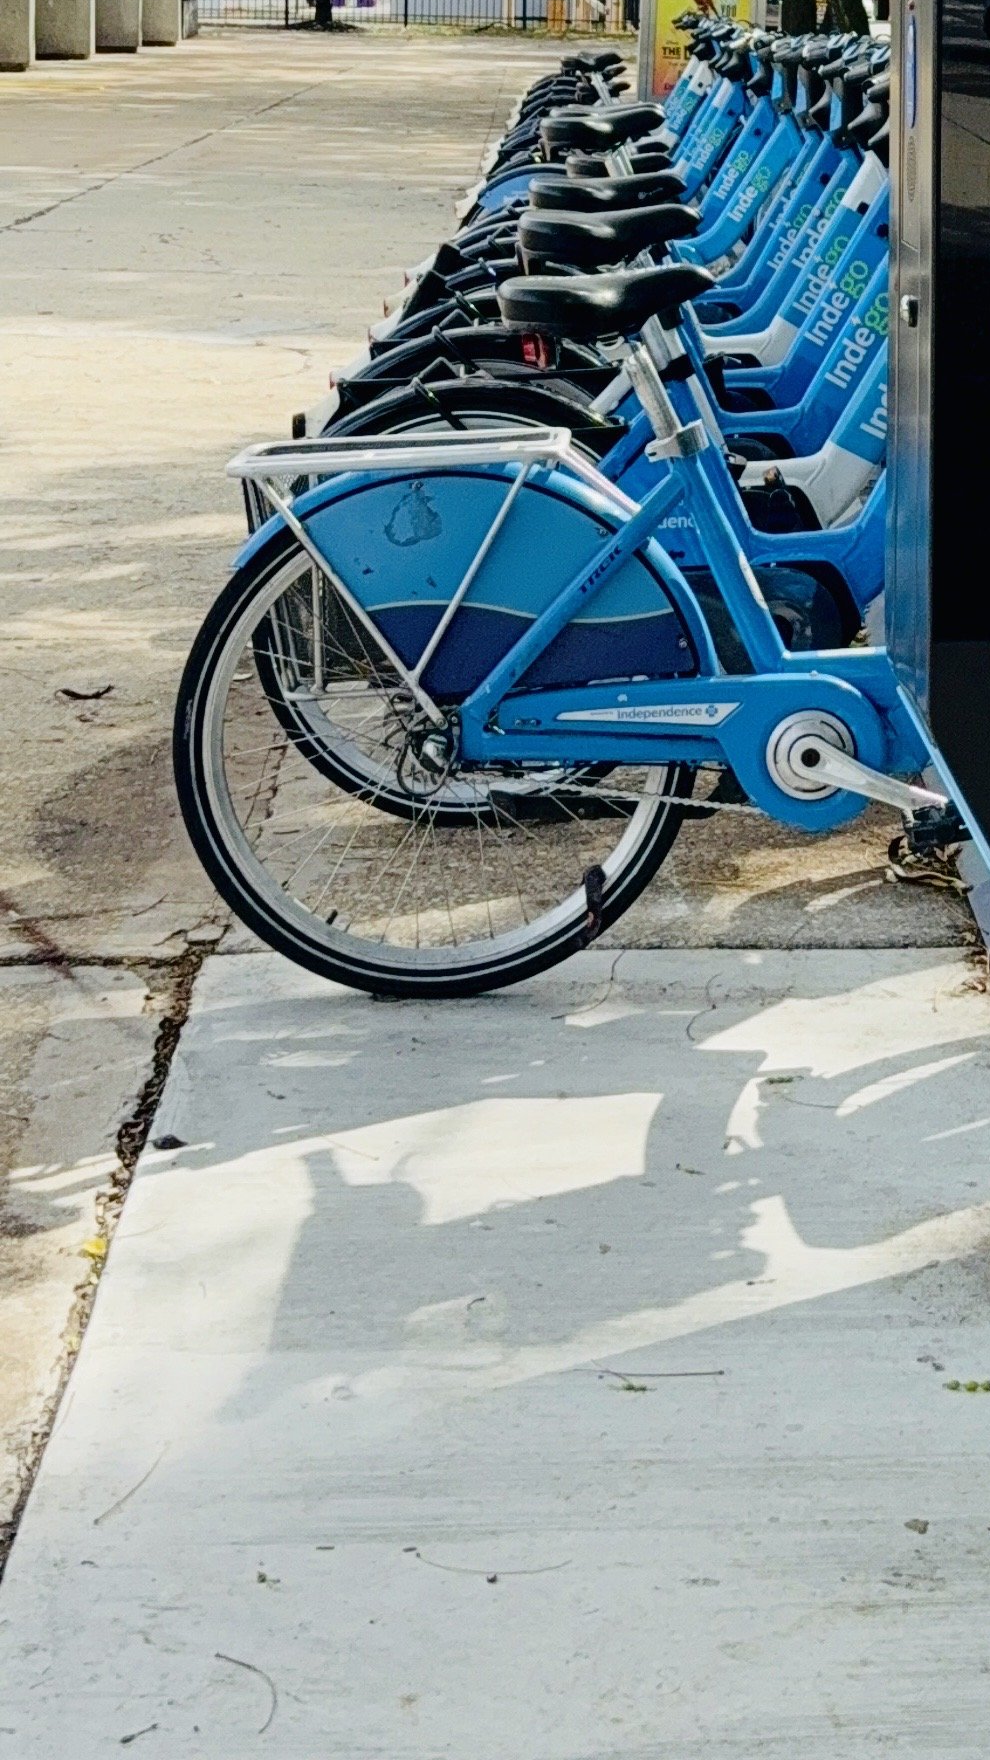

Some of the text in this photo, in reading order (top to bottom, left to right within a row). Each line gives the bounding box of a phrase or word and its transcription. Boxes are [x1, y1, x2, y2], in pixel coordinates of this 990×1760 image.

[662, 46, 681, 56] THE
[713, 150, 751, 200] Indego
[727, 166, 772, 222] Indego
[793, 235, 851, 315] Indego
[803, 260, 869, 348] Indego
[824, 292, 889, 390] Indego
[617, 708, 703, 721] Independence
